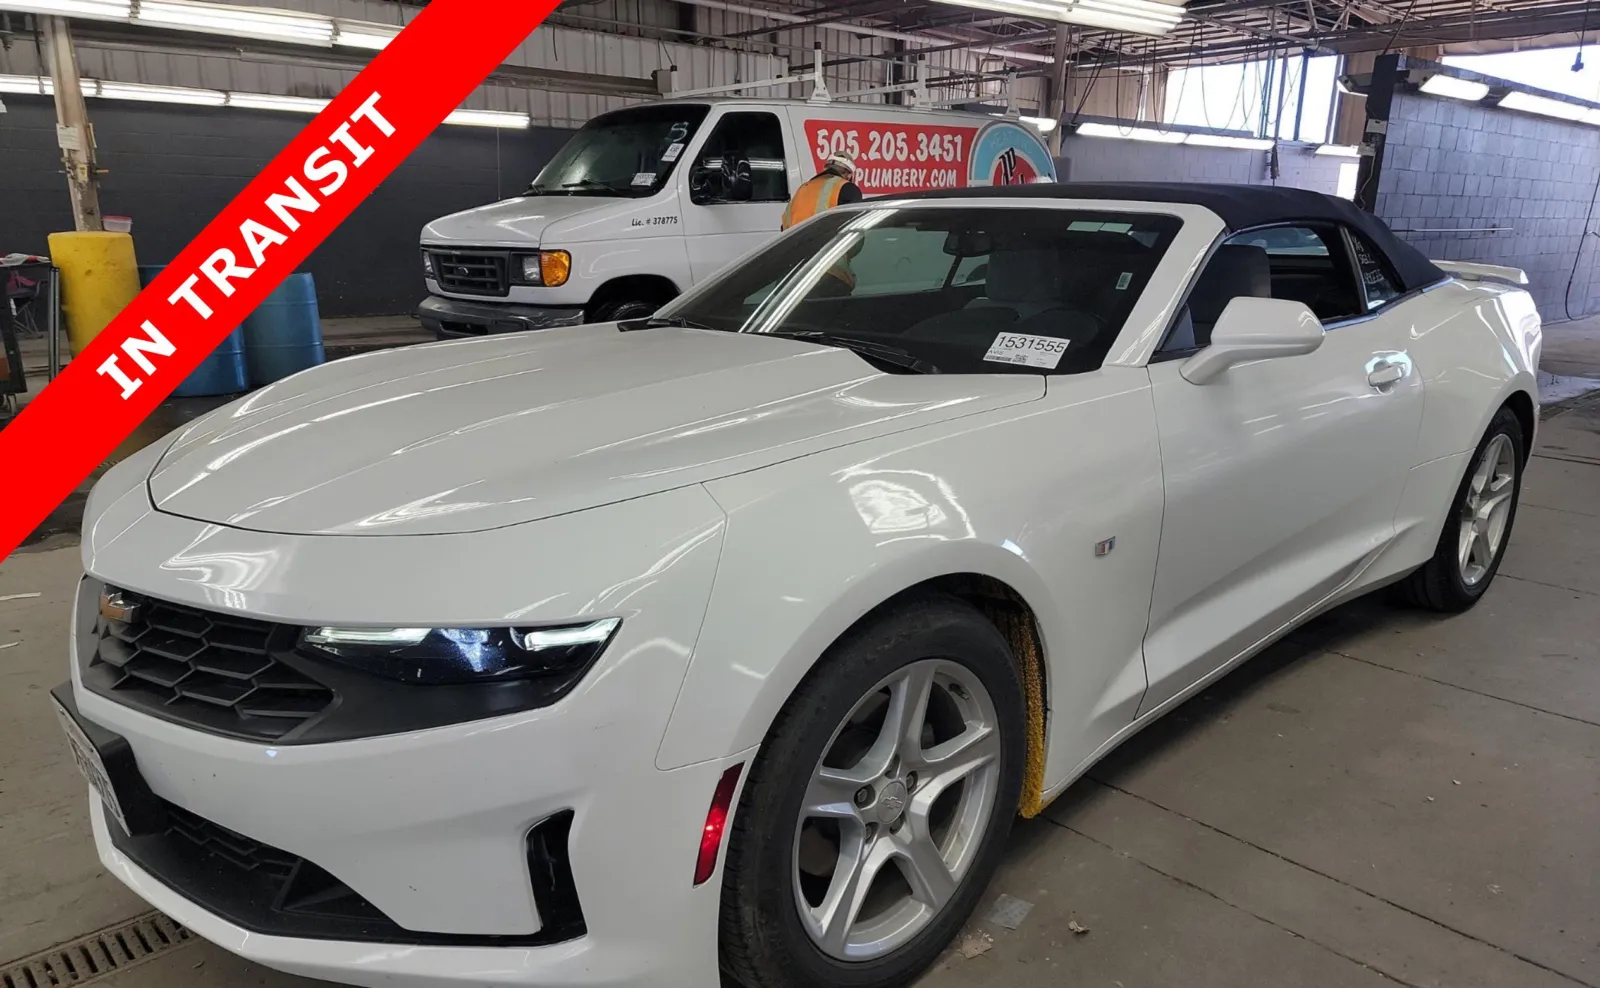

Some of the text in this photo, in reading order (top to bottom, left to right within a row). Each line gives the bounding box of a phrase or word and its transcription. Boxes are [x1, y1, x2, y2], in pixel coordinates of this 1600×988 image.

[816, 128, 962, 163] 505.205.3451
[632, 215, 678, 227] Lic. # 378775
[999, 336, 1066, 353] 1531555
